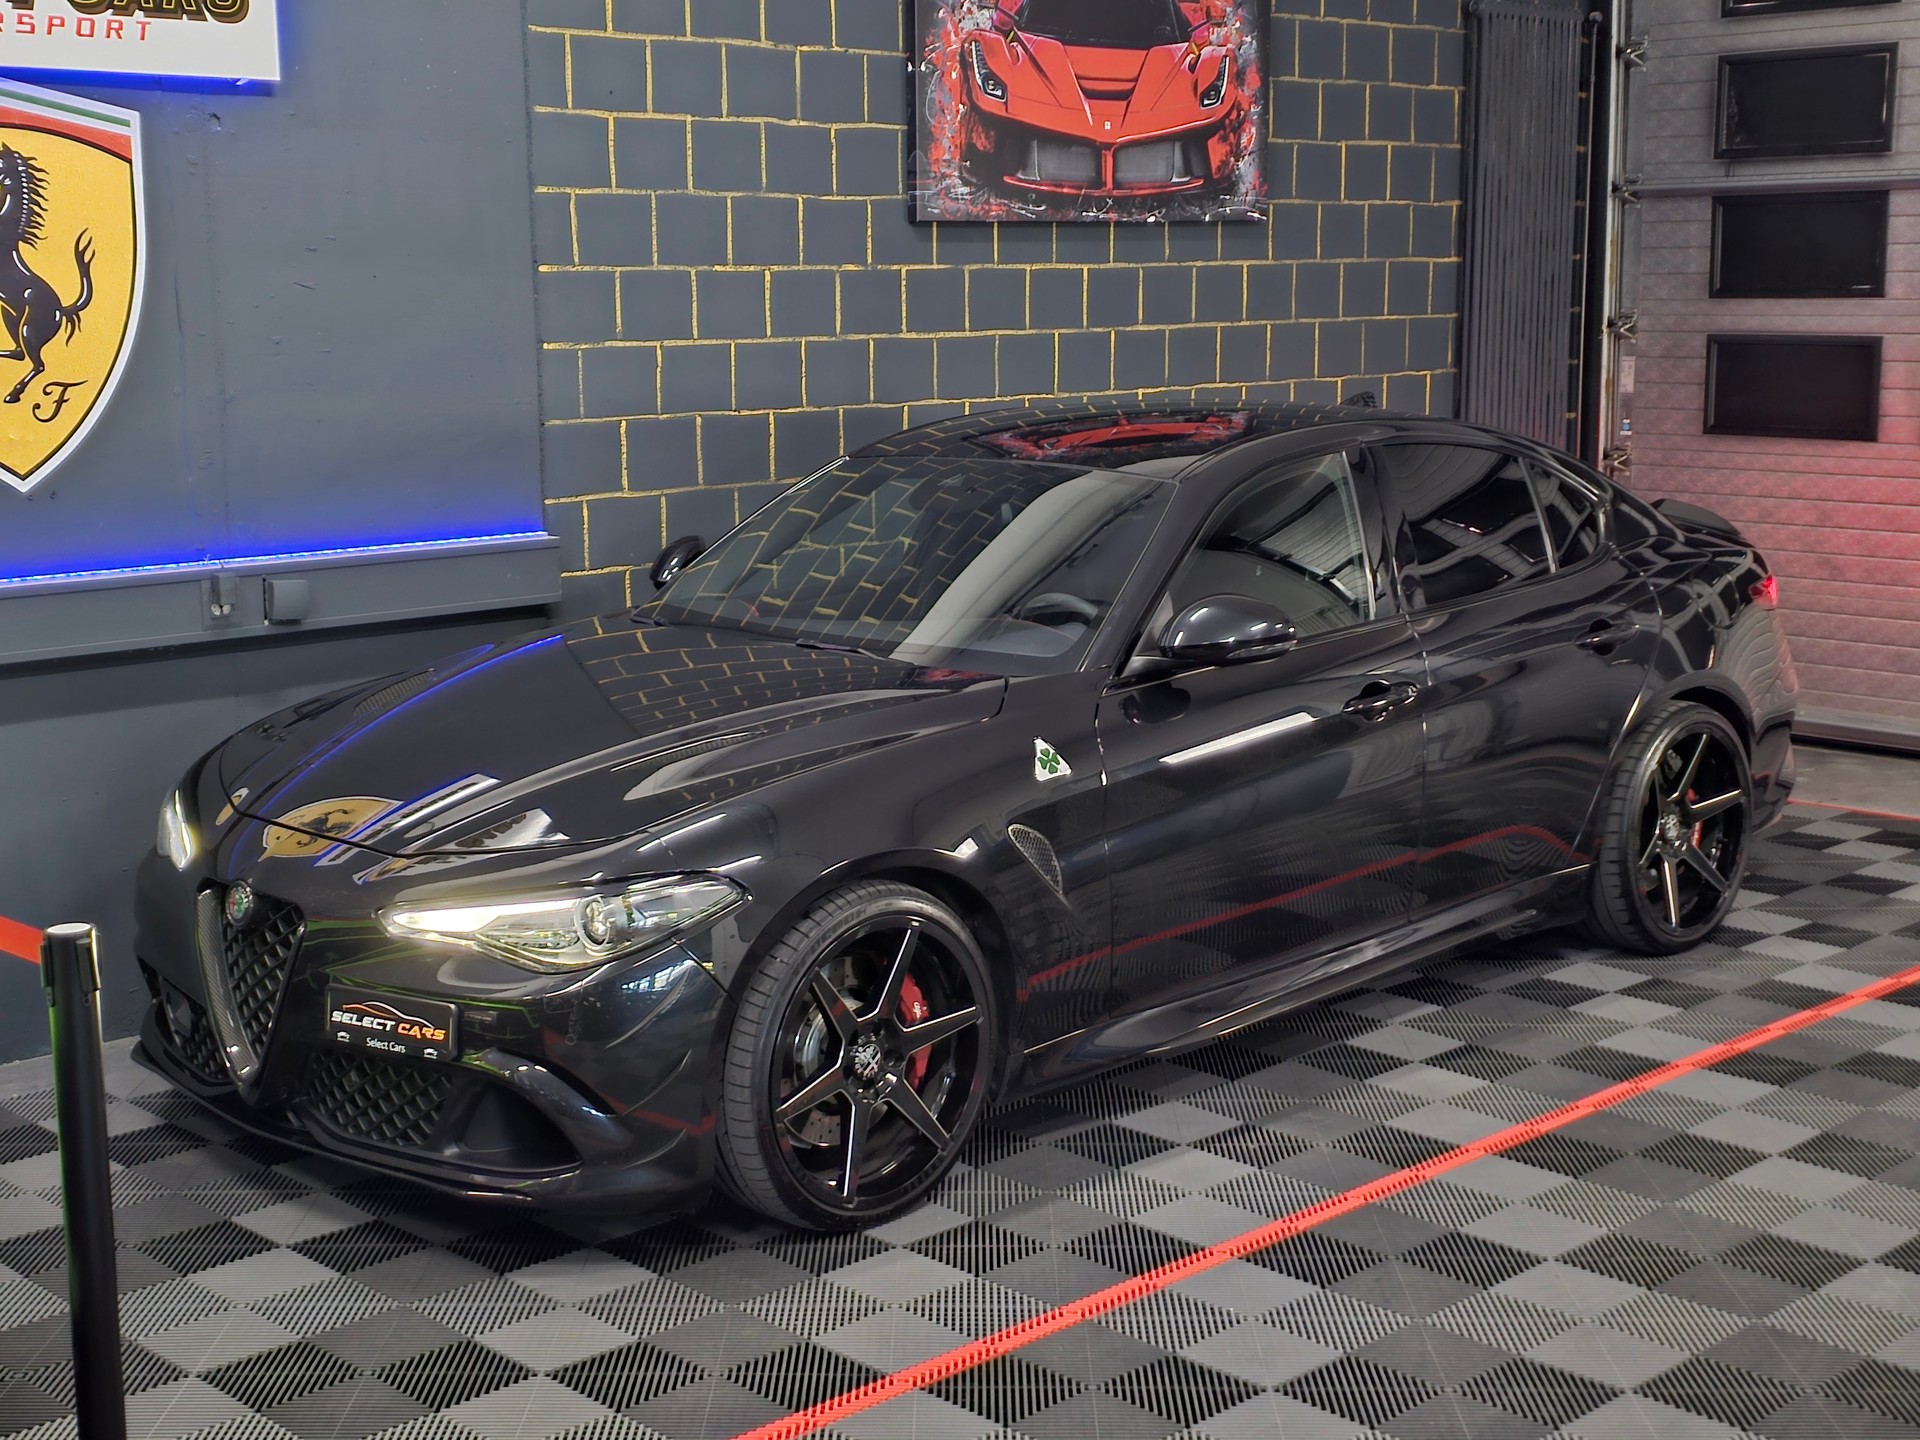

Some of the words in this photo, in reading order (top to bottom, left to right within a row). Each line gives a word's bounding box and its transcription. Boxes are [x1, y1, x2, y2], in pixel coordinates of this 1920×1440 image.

[0, 12, 151, 40] SPORT
[32, 379, 89, 423] F
[331, 1010, 396, 1031] SELECT
[397, 1023, 446, 1040] CARS
[366, 1037, 389, 1051] Select
[389, 1041, 406, 1054] Cars
